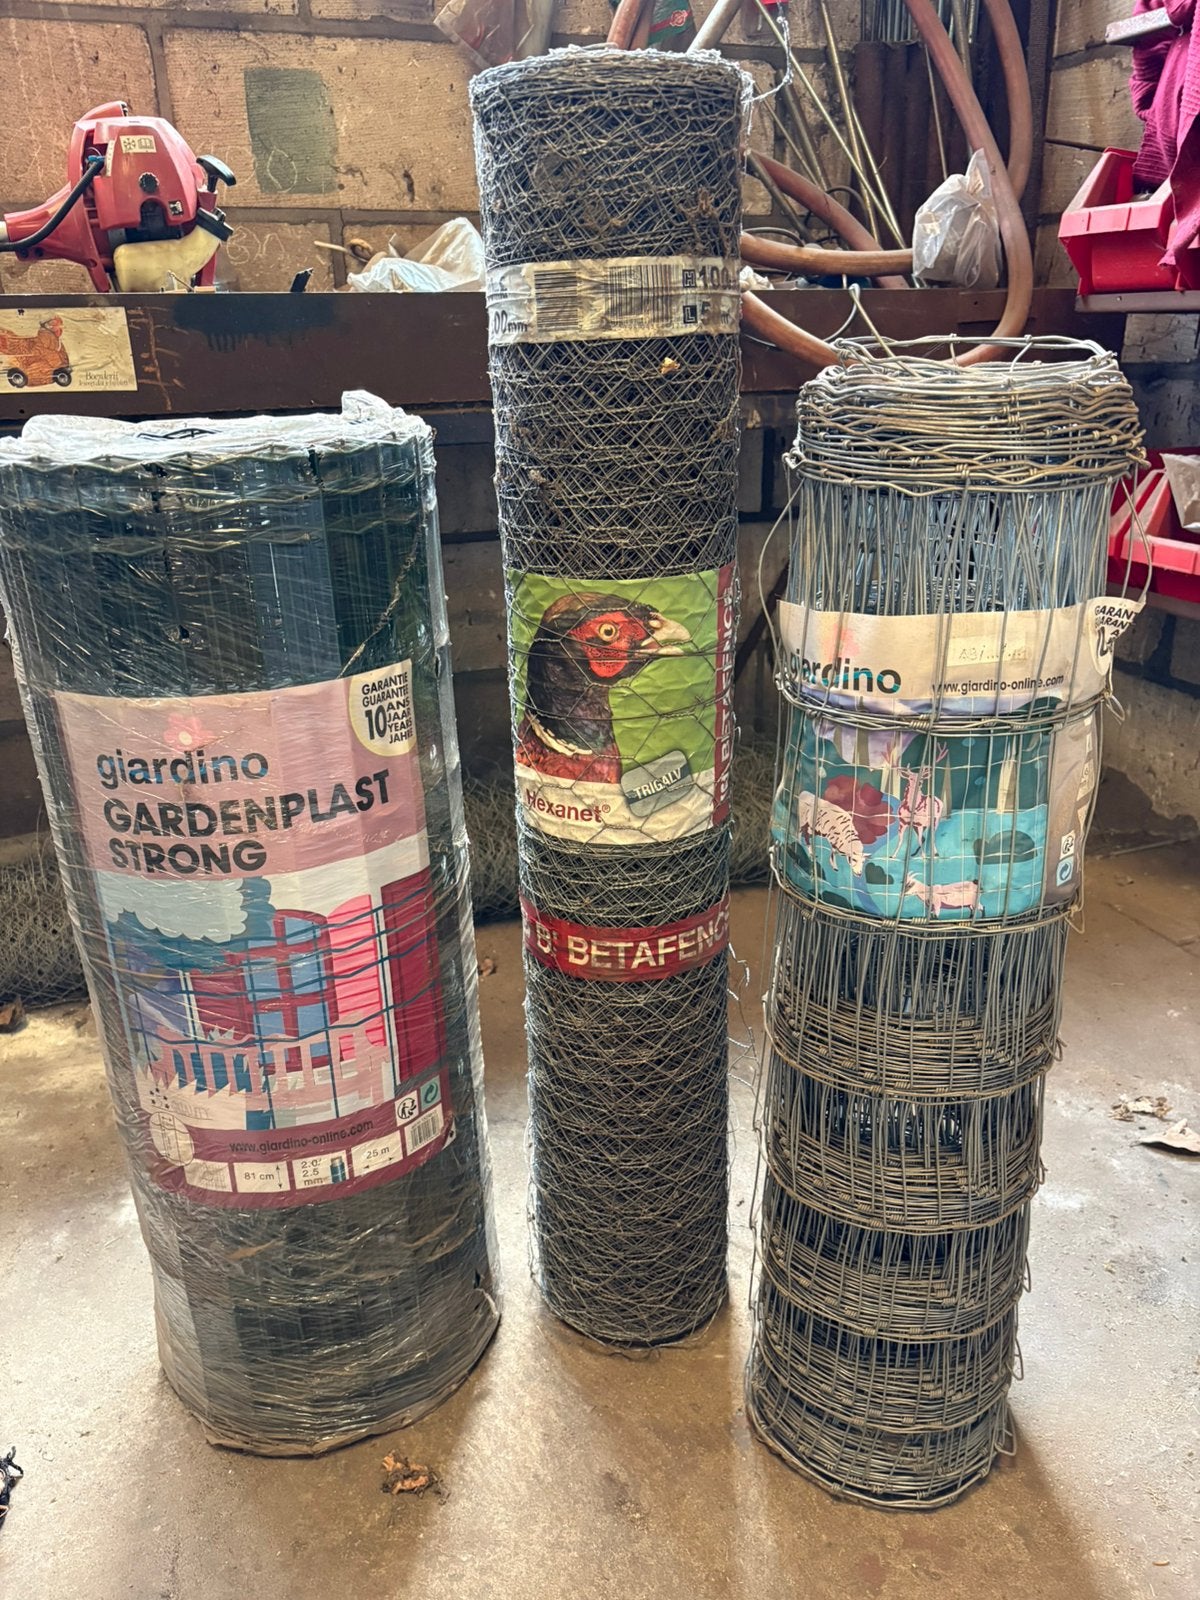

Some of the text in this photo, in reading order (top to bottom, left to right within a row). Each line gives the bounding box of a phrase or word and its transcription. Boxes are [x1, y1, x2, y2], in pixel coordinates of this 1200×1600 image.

[361, 671, 408, 695] GARANTIE
[362, 684, 409, 707] GUARANTEE
[364, 696, 410, 740] 10 ANS
[387, 707, 411, 723] JAAR
[388, 717, 413, 732] YEARS
[97, 749, 269, 789] giardino
[632, 767, 682, 799] TRIGALV
[104, 769, 390, 838] GARDENPLAST
[108, 837, 267, 874] STRONG
[229, 1119, 375, 1155] www.giardino-online.com
[366, 1146, 390, 1159] 25 m
[259, 1173, 275, 1181] cm
[302, 1168, 319, 1178] 2.5
[303, 1177, 324, 1186] mm
